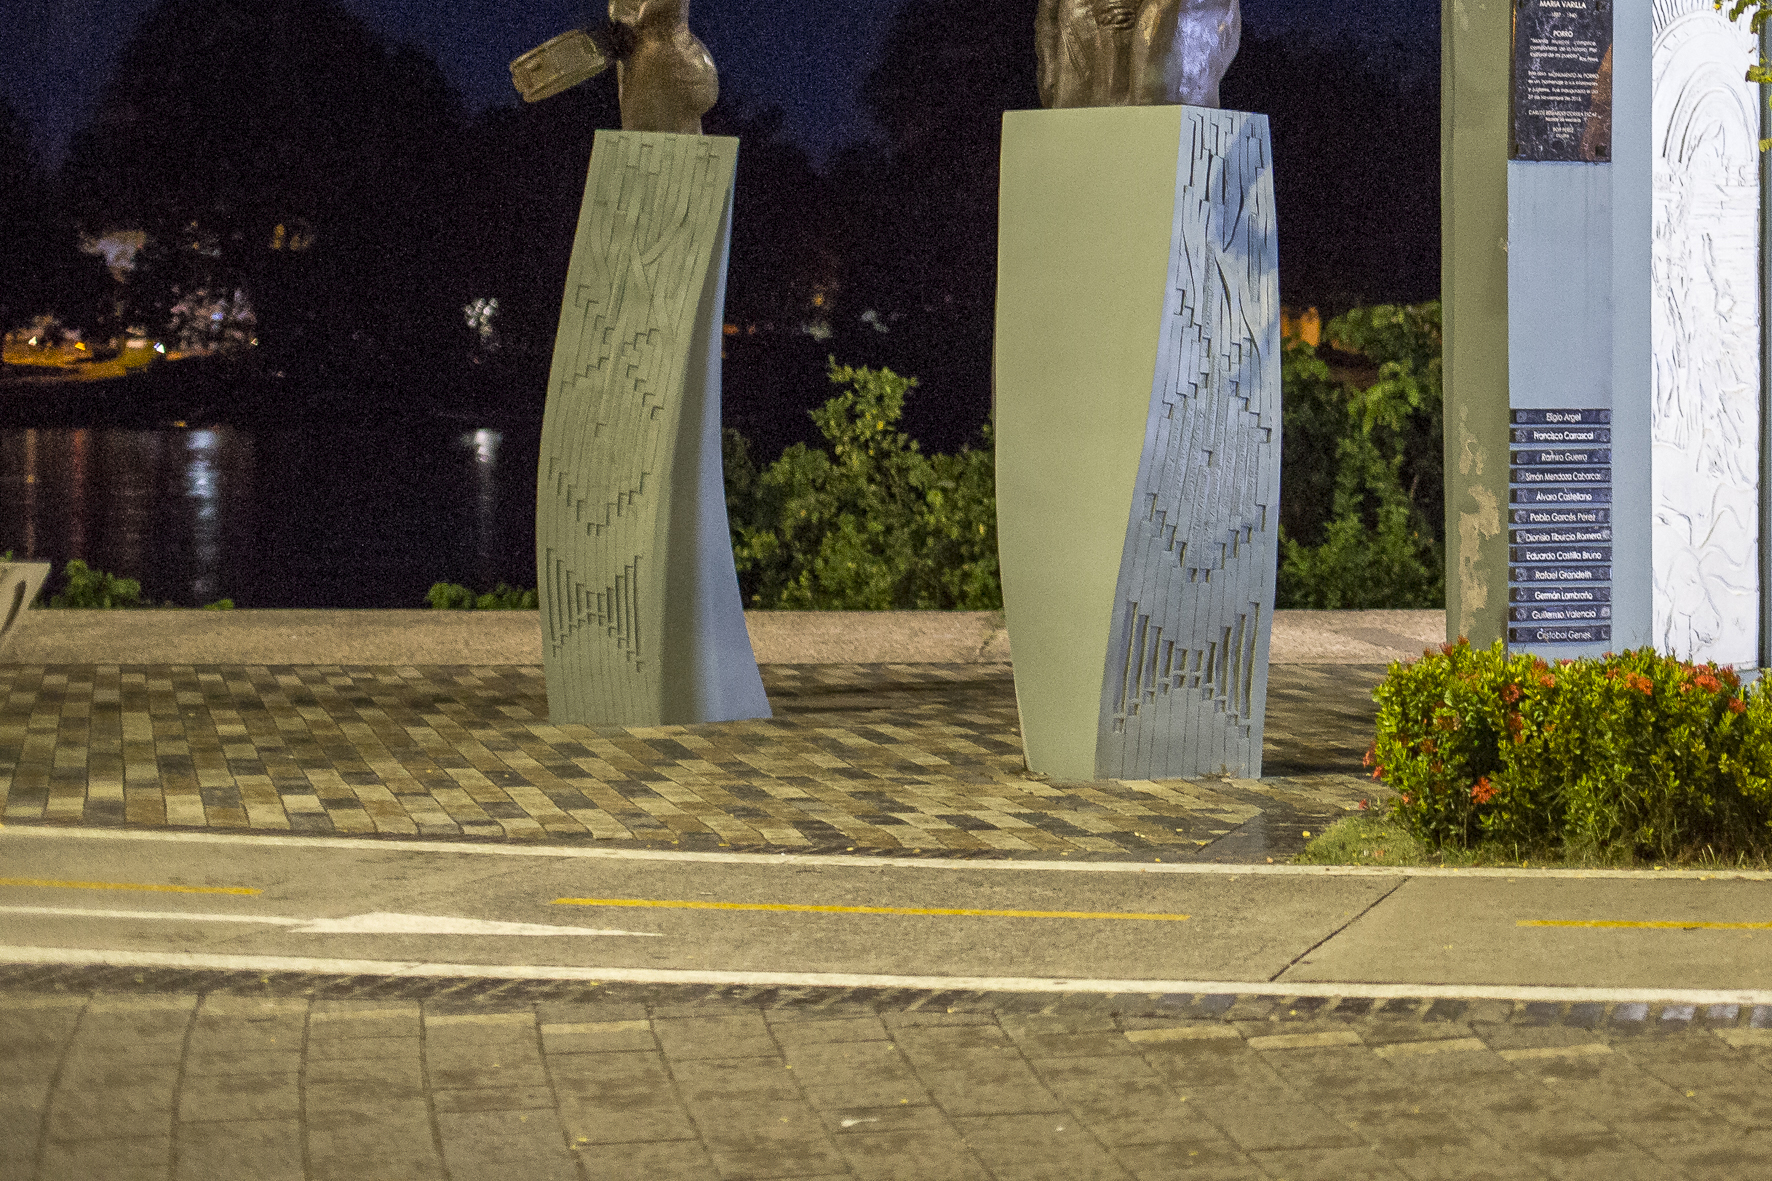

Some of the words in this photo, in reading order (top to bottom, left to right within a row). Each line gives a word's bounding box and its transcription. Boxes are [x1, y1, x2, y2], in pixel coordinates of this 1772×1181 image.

[1533, 430, 1563, 440] Francisco
[1530, 512, 1550, 521] Pablo
[1526, 551, 1555, 560] Eduardo
